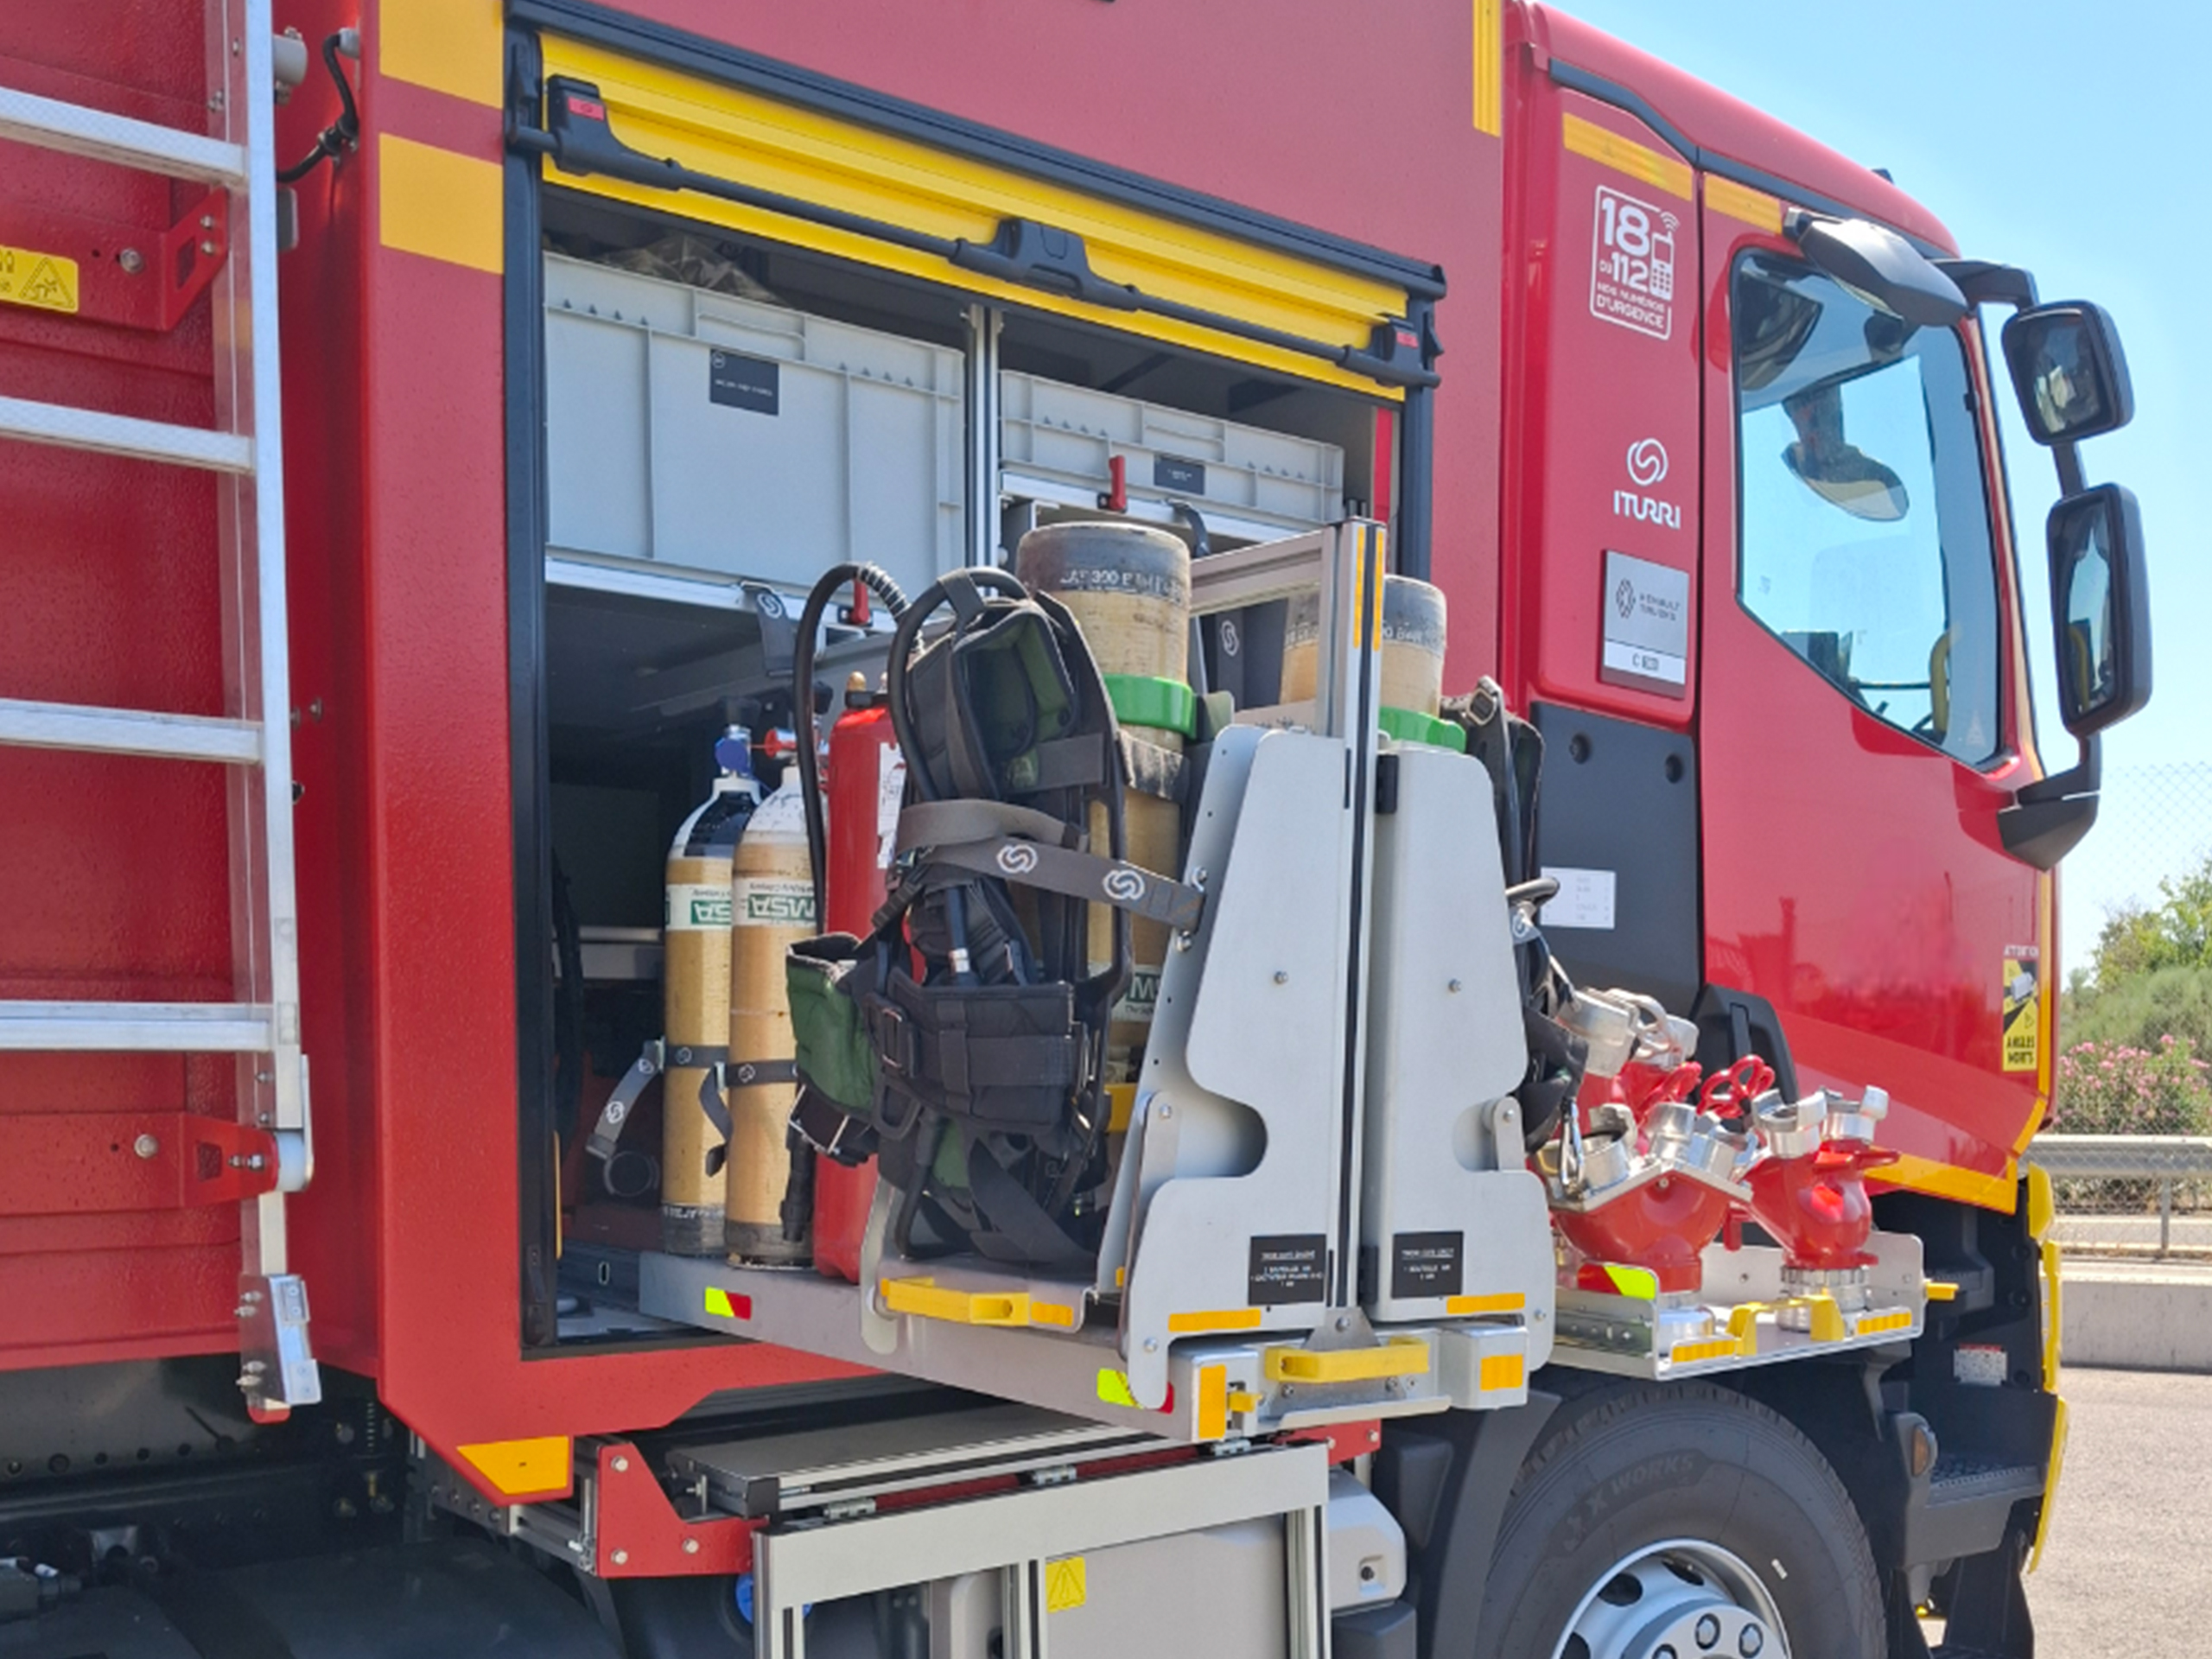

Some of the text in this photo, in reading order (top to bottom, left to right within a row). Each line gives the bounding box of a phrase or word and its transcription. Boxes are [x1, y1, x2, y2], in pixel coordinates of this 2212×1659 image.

[1602, 197, 1650, 257] 18
[1611, 251, 1649, 293] 112
[1613, 489, 1681, 530] ITURRI
[751, 896, 816, 918] MSA
[1610, 1453, 1694, 1496] WORKS
